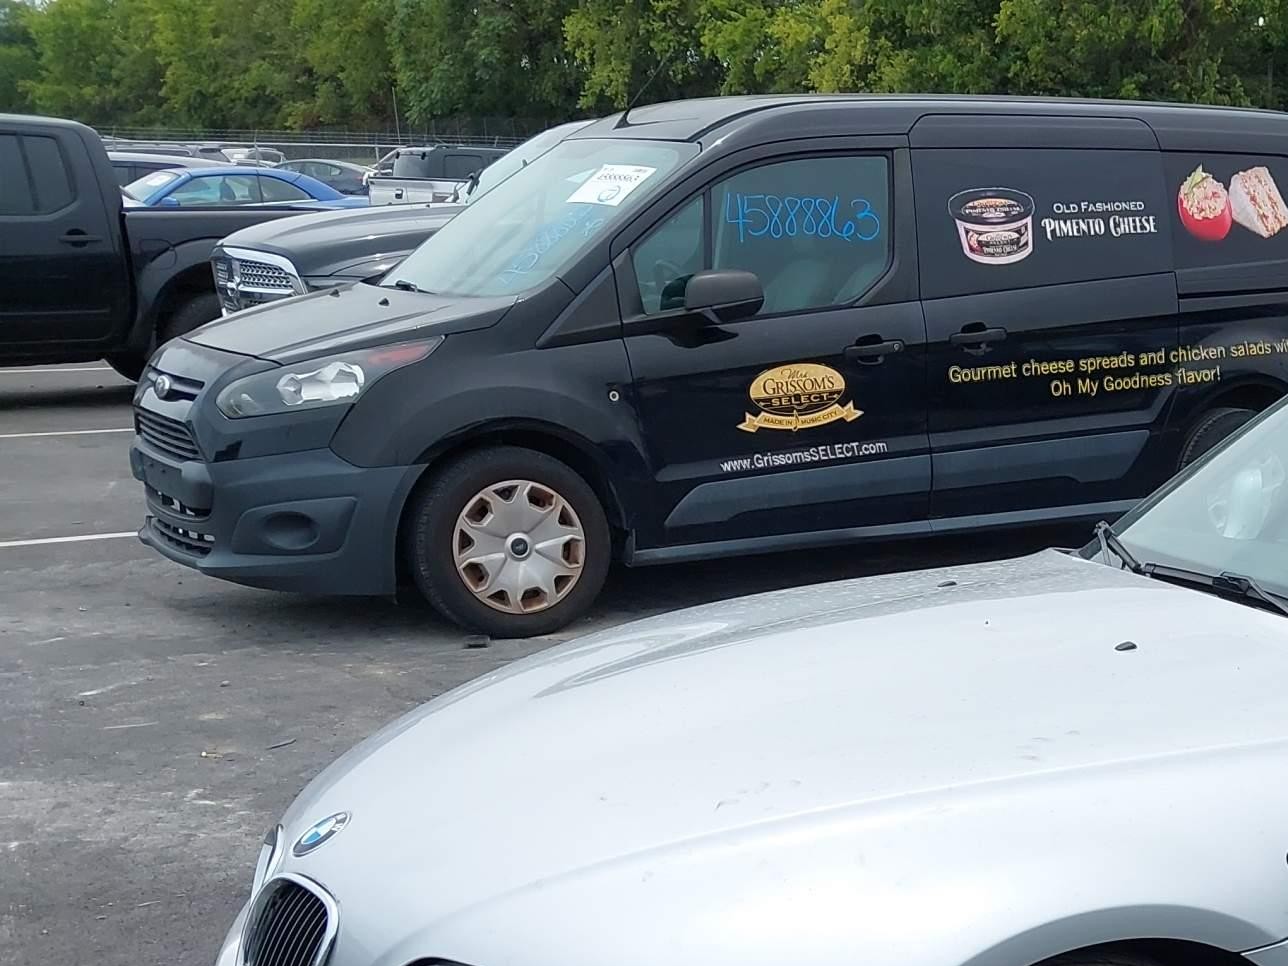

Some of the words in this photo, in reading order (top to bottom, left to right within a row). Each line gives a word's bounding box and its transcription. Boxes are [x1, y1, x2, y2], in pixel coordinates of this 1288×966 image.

[726, 192, 880, 243] 45888863
[1041, 217, 1105, 241] PIMENTO
[1109, 214, 1158, 237] CHEESE
[949, 360, 1017, 383] Gourmet
[1022, 358, 1075, 377] cheese
[1079, 350, 1135, 374] spreads
[1139, 347, 1166, 366] and
[1169, 344, 1227, 363] chicken
[1231, 339, 1273, 358] salads
[1051, 379, 1072, 397] Oh
[1077, 377, 1099, 397] My
[1103, 371, 1172, 392] Goodness
[1175, 364, 1222, 385] flavor!
[771, 392, 831, 407] SELECT
[763, 416, 785, 425] MADE
[800, 416, 822, 425] MUSIC
[719, 440, 889, 473] www.GrissomsSELECT.com
